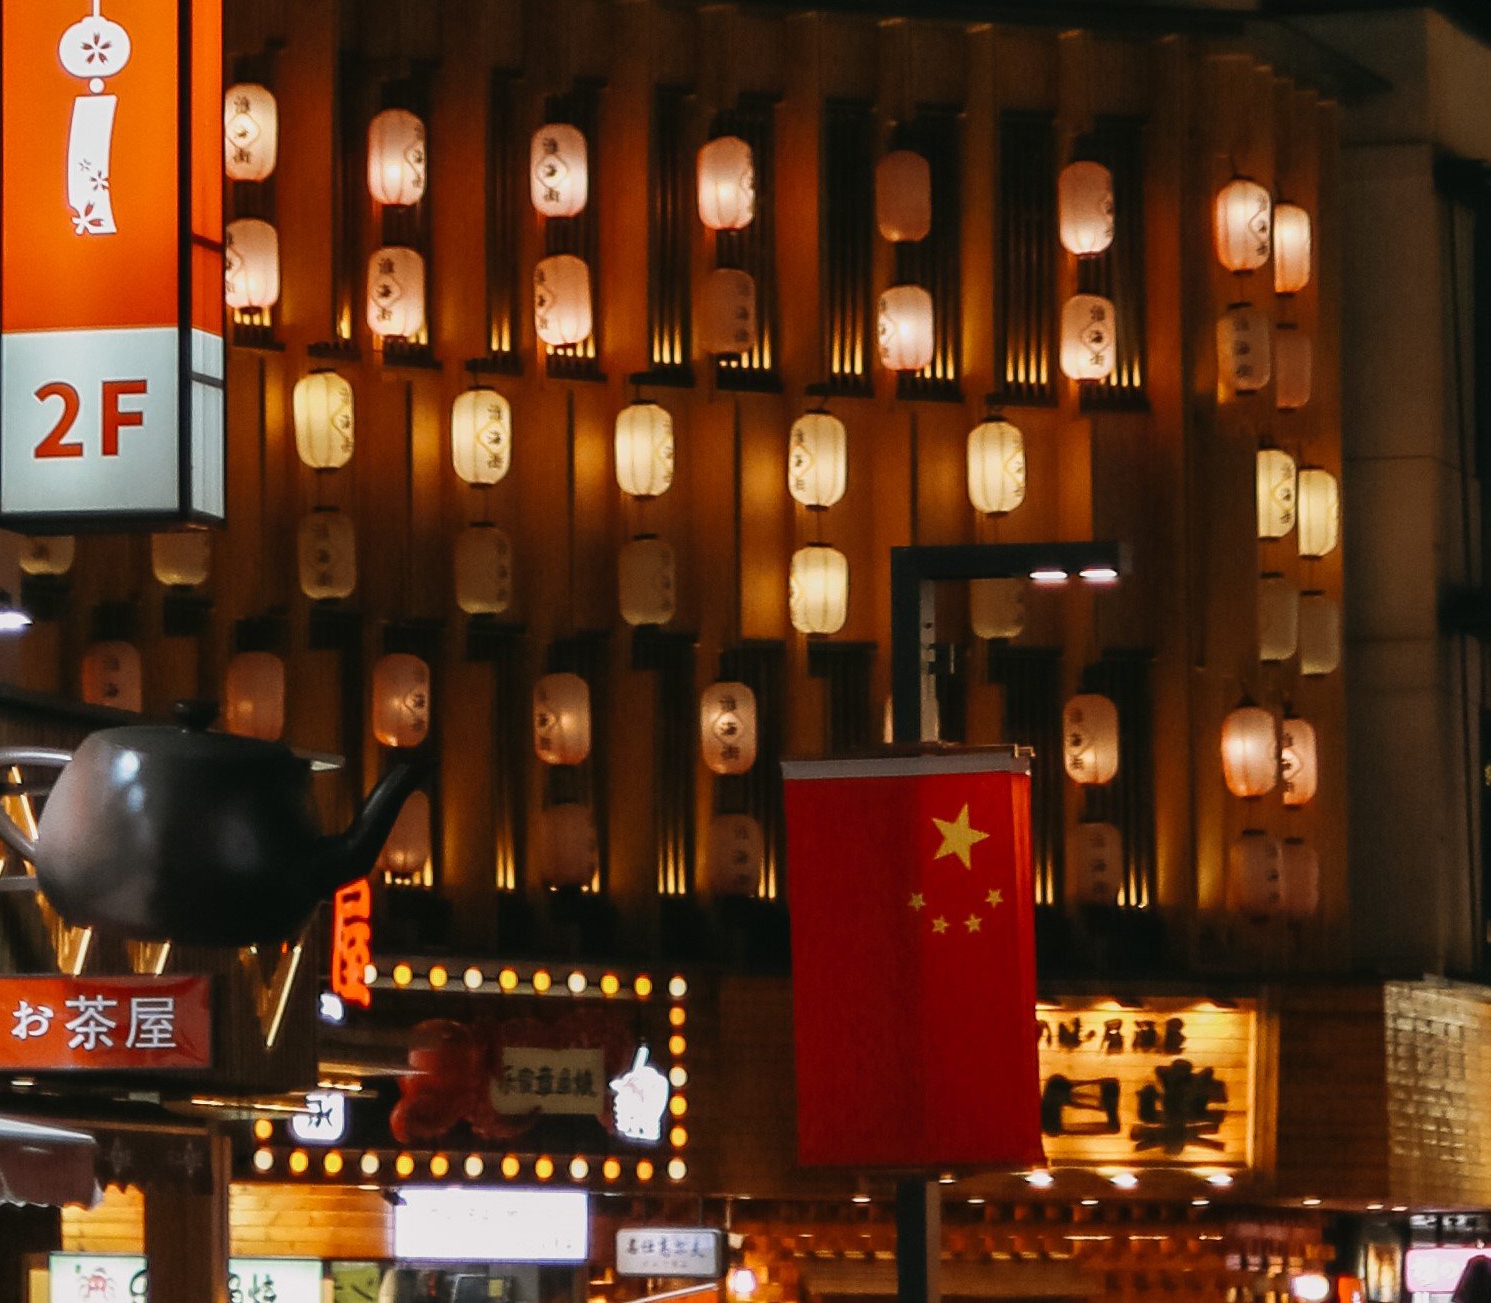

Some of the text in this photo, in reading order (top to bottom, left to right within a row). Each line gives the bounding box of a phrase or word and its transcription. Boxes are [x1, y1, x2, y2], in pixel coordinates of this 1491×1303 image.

[34, 381, 148, 458] 2F
[10, 995, 177, 1050] お茶屋
